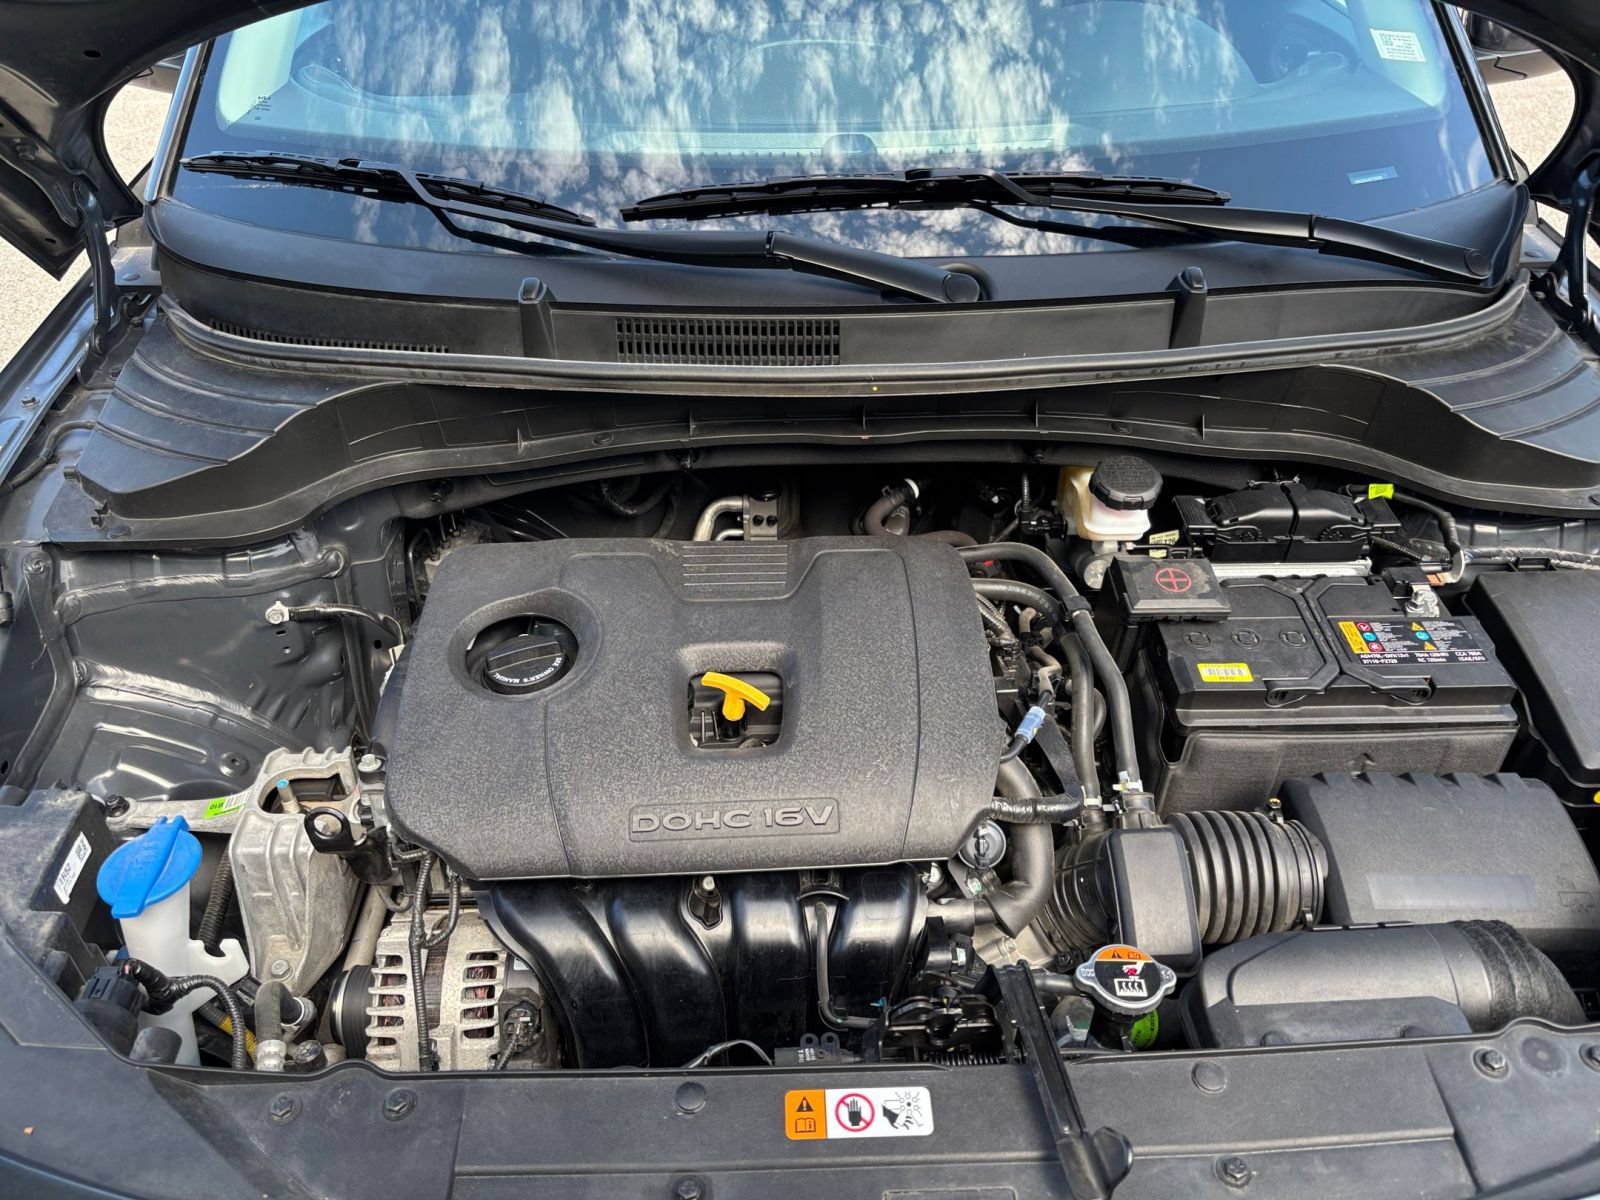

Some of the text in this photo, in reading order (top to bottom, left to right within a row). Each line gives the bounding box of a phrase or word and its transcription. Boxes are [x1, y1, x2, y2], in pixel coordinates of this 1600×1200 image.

[493, 657, 563, 684] SEE OWNER'S MANUAL
[631, 805, 834, 833] DOHC 16V
